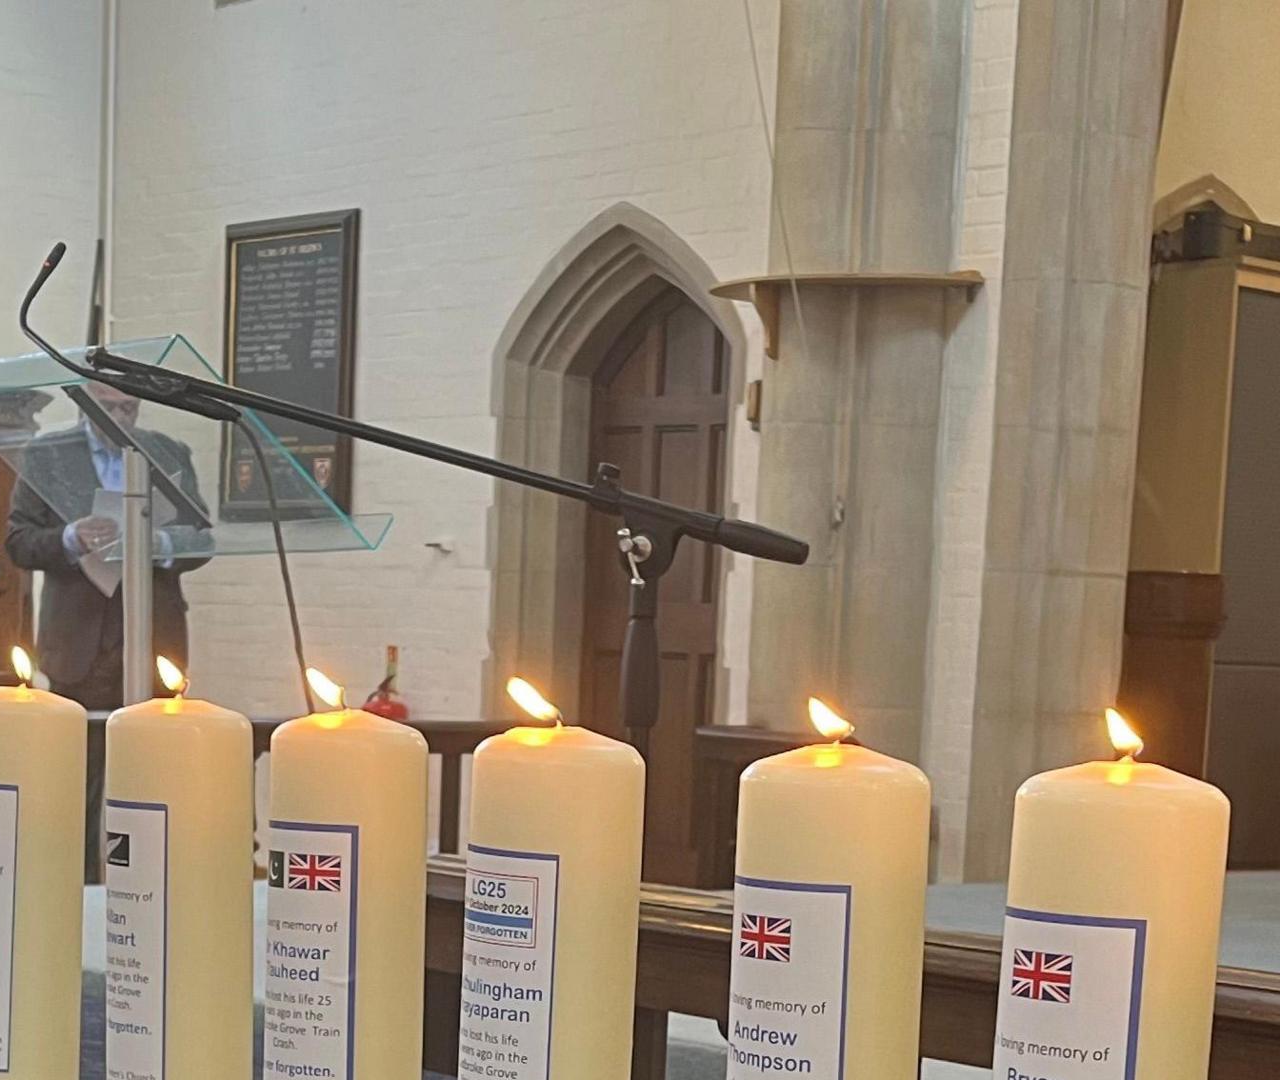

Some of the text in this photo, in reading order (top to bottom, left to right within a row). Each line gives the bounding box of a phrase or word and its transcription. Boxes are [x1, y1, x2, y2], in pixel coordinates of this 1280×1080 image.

[142, 892, 153, 902] of
[472, 879, 507, 899] LG25
[501, 903, 529, 916] 2024
[282, 920, 323, 934] memory
[325, 921, 338, 933] of
[476, 924, 528, 940] FORGOTTEN
[273, 941, 330, 961] Khawar
[478, 955, 520, 972] memory
[523, 960, 537, 972] of
[132, 973, 150, 985] the
[299, 994, 314, 1006] life
[317, 995, 332, 1006] 25
[755, 998, 807, 1016] memory
[811, 1001, 826, 1015] of
[305, 1010, 324, 1021] the
[280, 1022, 340, 1037] Grove Train
[734, 1020, 798, 1046] Andrew
[485, 1032, 499, 1045] his
[501, 1034, 519, 1047] life
[476, 1048, 492, 1062] ago
[494, 1049, 505, 1062] in
[508, 1051, 528, 1065] the
[730, 1042, 812, 1073] Thompson
[1027, 1041, 1088, 1063] memory
[1092, 1047, 1111, 1061] of
[275, 1060, 336, 1078] forgotten.
[486, 1065, 518, 1080] Grove
